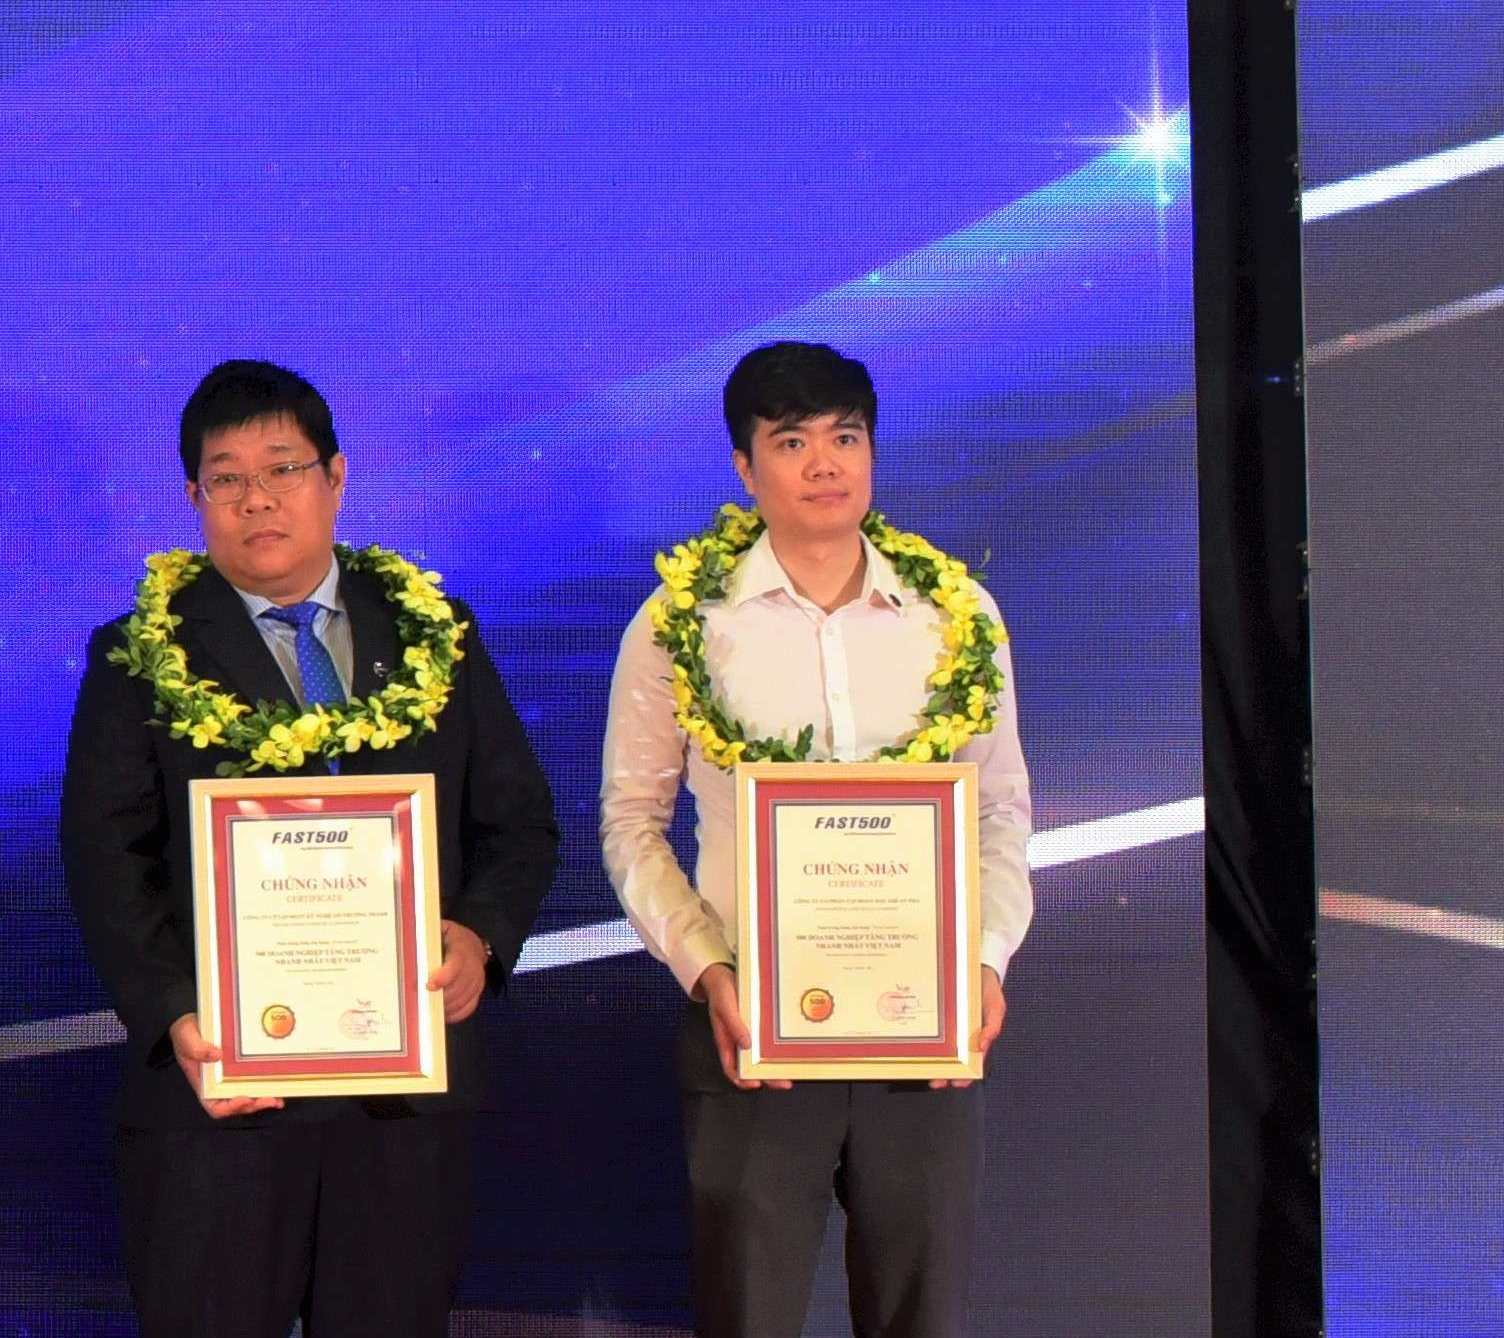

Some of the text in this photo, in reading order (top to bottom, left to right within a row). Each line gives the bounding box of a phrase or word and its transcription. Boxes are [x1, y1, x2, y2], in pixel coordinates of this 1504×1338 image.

[814, 816, 891, 830] FAST500
[272, 831, 348, 844] FAST500
[803, 861, 909, 877] CHỨNG NHẬN
[261, 876, 367, 891] CHỨNG NHẬN
